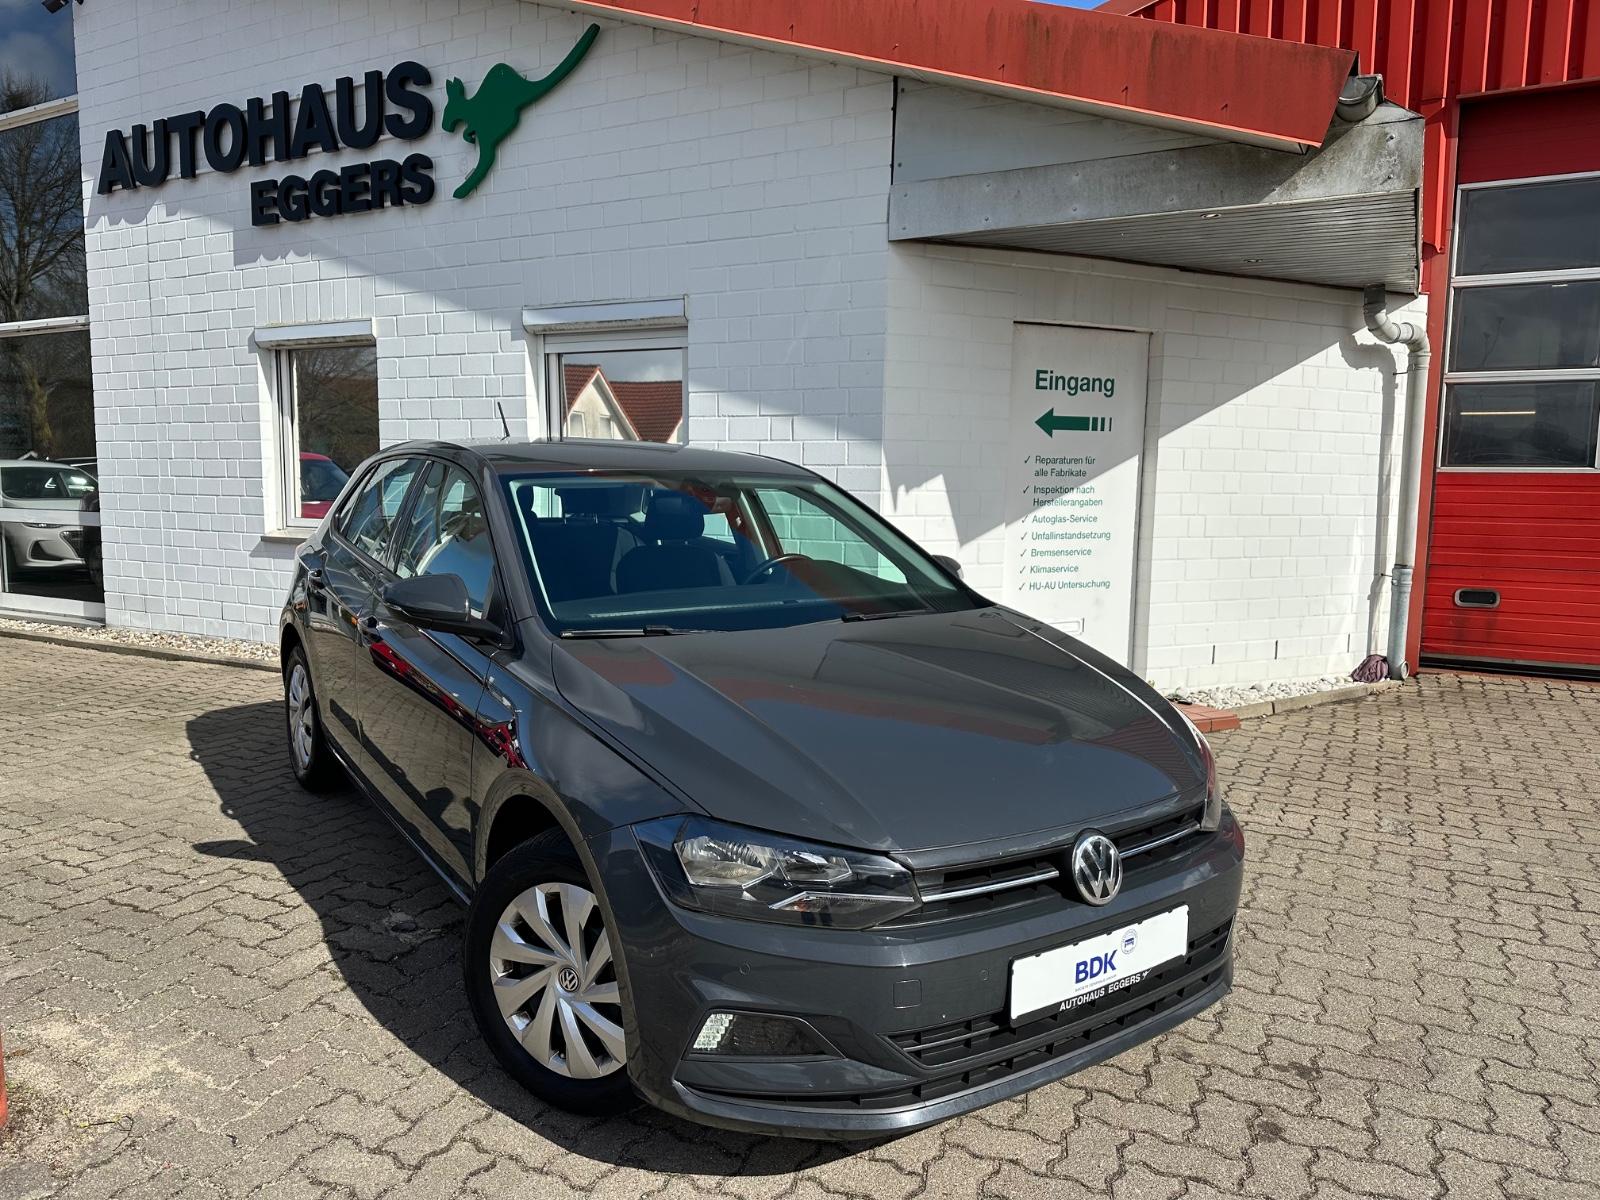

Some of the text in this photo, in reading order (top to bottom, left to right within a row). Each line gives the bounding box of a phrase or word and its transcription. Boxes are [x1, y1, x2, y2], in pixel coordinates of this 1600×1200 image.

[97, 60, 433, 194] AUTOHAUS
[250, 153, 435, 226] EGGERS
[1035, 369, 1115, 398] Eingang
[1035, 455, 1083, 466] Reparaturen
[1034, 467, 1087, 477] alle Fabrikate
[1033, 485, 1095, 495] Inspektion nach
[1033, 497, 1103, 507] Herstellerangaben
[1032, 514, 1098, 525] Autoglas-Service
[1031, 531, 1111, 541] Unfallinstandsetzung
[1030, 548, 1092, 557] Bremsenservice
[1030, 565, 1079, 574] Klimaservice
[1029, 580, 1111, 590] HU-AU Untersuchung
[1075, 949, 1117, 984] BDK
[1059, 987, 1105, 1012] AUTOHAUS
[1108, 973, 1141, 994] EGGERS
